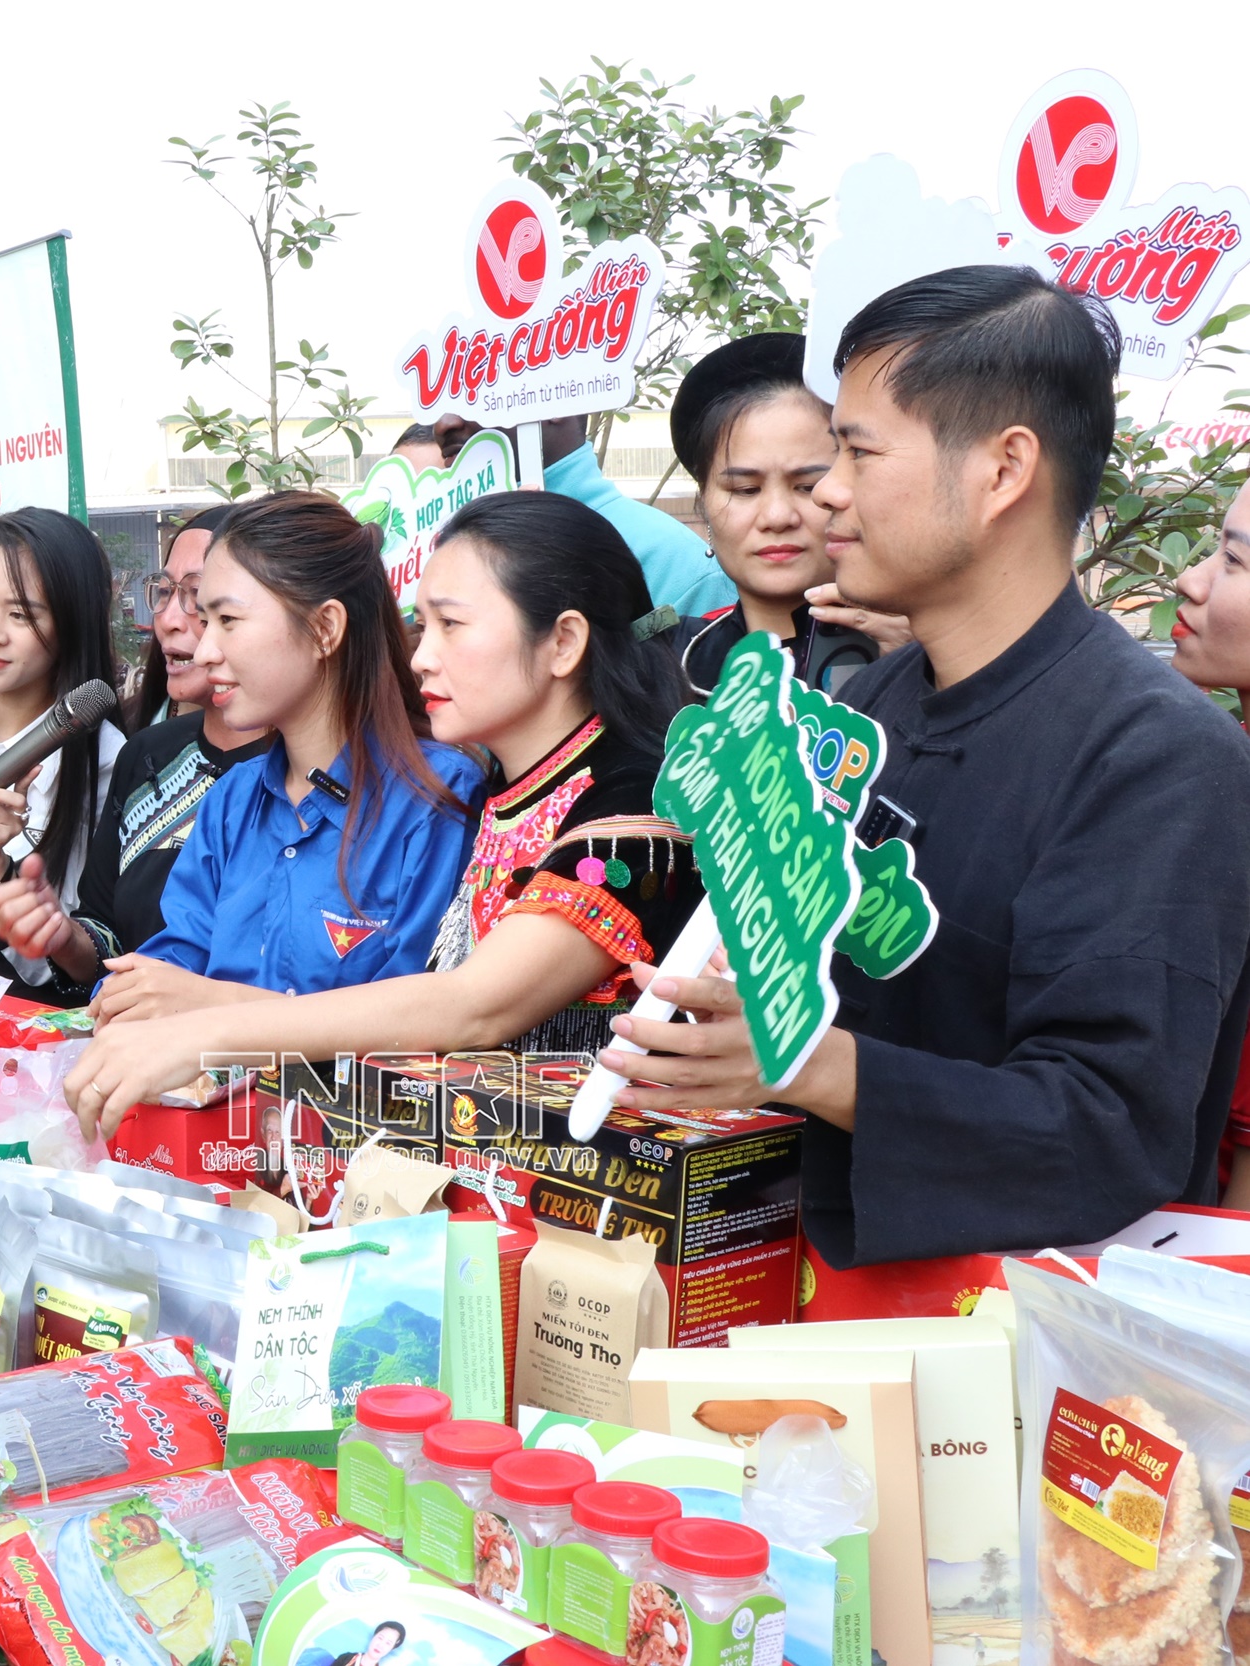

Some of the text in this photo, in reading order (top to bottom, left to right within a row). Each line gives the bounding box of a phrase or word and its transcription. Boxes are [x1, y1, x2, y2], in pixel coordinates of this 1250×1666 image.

[1139, 206, 1241, 251] Miến
[577, 254, 651, 300] Miến
[1123, 333, 1166, 358] nhiên
[403, 326, 505, 409] Việt
[483, 375, 620, 411] Sản phẩm từ thiên nhiên
[6, 423, 62, 464] NGUYÊN
[416, 459, 495, 532] HỢP TÁC XÃ
[386, 535, 421, 600] yết
[826, 793, 850, 813] VIETNAM
[741, 730, 800, 855] NÔNG
[782, 836, 836, 944] SẢN
[706, 786, 756, 893] THÁI
[731, 865, 812, 1059] NGUYÊN
[846, 865, 918, 959] ên
[400, 1077, 434, 1096] OCOP
[630, 1138, 673, 1161] OCOP
[605, 1156, 662, 1200] Đen
[696, 1266, 715, 1277] CHUẨN
[258, 1299, 323, 1324] NEM THÍNH
[578, 1297, 610, 1314] OCOP
[89, 1320, 119, 1334] Natural
[255, 1331, 318, 1360] DÂN TỘC
[534, 1322, 621, 1370] Trường Thọ
[542, 1312, 609, 1341] MIẾN TỎI ĐEN
[251, 1375, 289, 1413] Sán
[931, 1439, 987, 1456] BÔNG
[251, 1472, 303, 1518] Miến
[26, 1586, 56, 1619] ngon
[47, 1620, 72, 1645] cho
